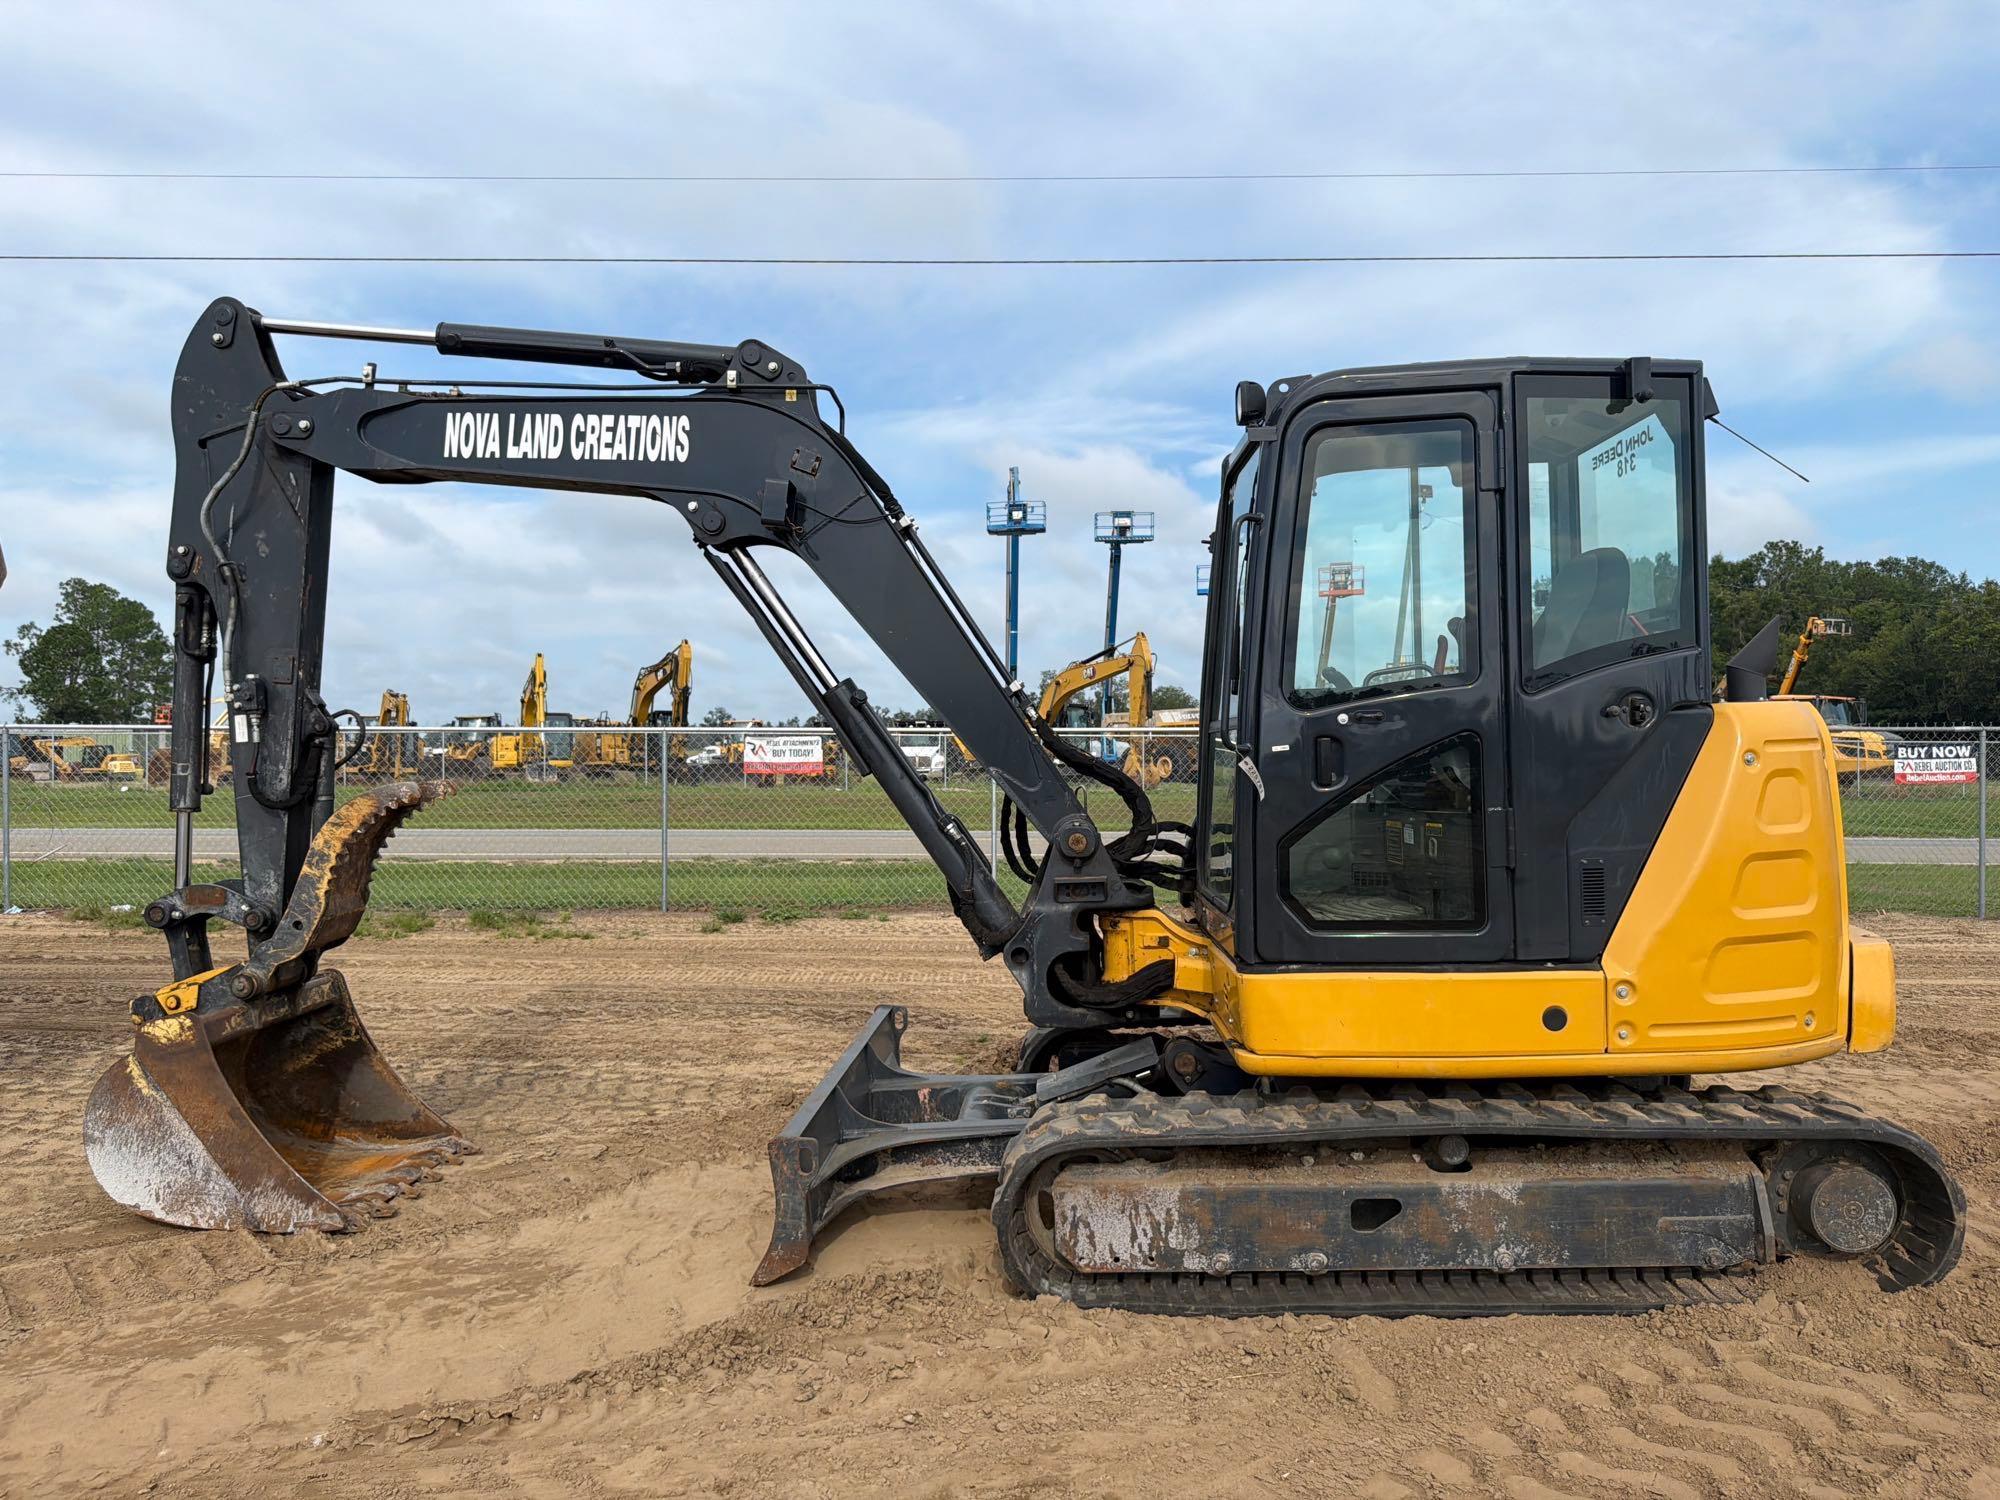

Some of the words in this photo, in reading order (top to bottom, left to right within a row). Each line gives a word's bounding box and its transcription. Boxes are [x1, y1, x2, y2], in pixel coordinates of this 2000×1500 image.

[443, 411, 500, 460] NOVA
[506, 412, 564, 460] LAND
[570, 412, 690, 463] CREATIONS
[772, 749, 787, 758] BUY
[789, 749, 814, 758] TODAY!
[1897, 746, 1928, 759] BUY
[1932, 746, 1971, 758] NOW
[1914, 761, 1933, 772] REBEL
[1935, 761, 1962, 771] AUCTION
[1906, 773, 1966, 782] RebelAuction.com
